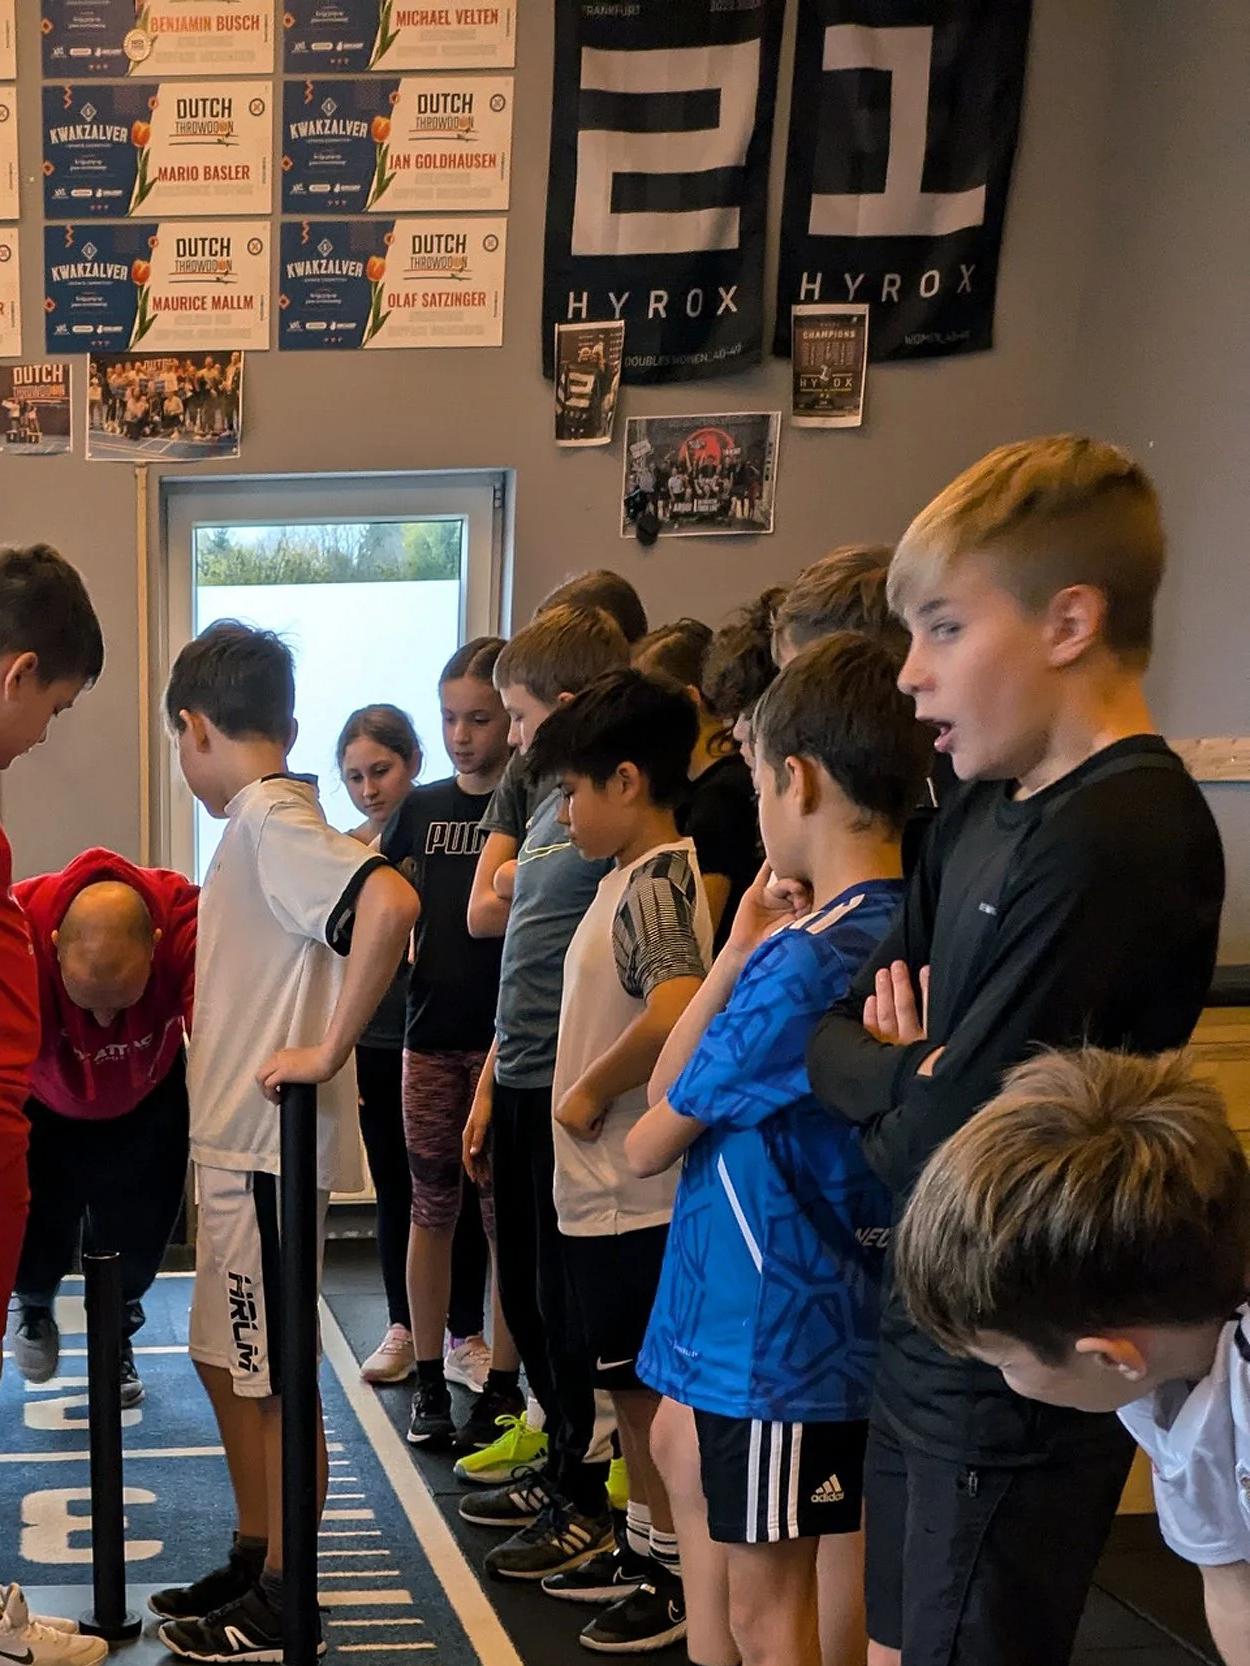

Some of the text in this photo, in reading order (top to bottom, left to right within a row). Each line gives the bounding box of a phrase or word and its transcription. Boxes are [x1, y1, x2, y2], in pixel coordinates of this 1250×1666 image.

[151, 15, 260, 32] BENJAMIN BUSCH
[396, 9, 499, 26] MICHAEL VELTEN
[177, 98, 232, 119] DUTCH
[417, 93, 473, 114] DUTCH
[50, 124, 128, 145] KWAKZALVER
[289, 119, 368, 140] KWAKZALVER
[808, 24, 986, 236] 1
[571, 38, 761, 256] 2
[389, 153, 497, 170] JAN GOLDHAUSEN
[158, 165, 250, 182] MARIO BASLER
[176, 237, 231, 257] DUTCH
[412, 234, 467, 255] DUTCH
[51, 264, 128, 281] KWAKZALVER
[287, 259, 363, 278] KWAKZALVER
[800, 264, 977, 302] HYROX
[152, 295, 254, 312] MAURICE MALLM
[388, 291, 487, 308] OLAF SATZINGER
[567, 285, 739, 319] HYROX
[803, 330, 856, 339] CHAMPIONS
[13, 364, 63, 385] DUTCH
[800, 377, 853, 388] HYOX
[425, 821, 486, 855] PUM
[228, 1271, 259, 1373] HRLM
[811, 1491, 845, 1503] adidas
